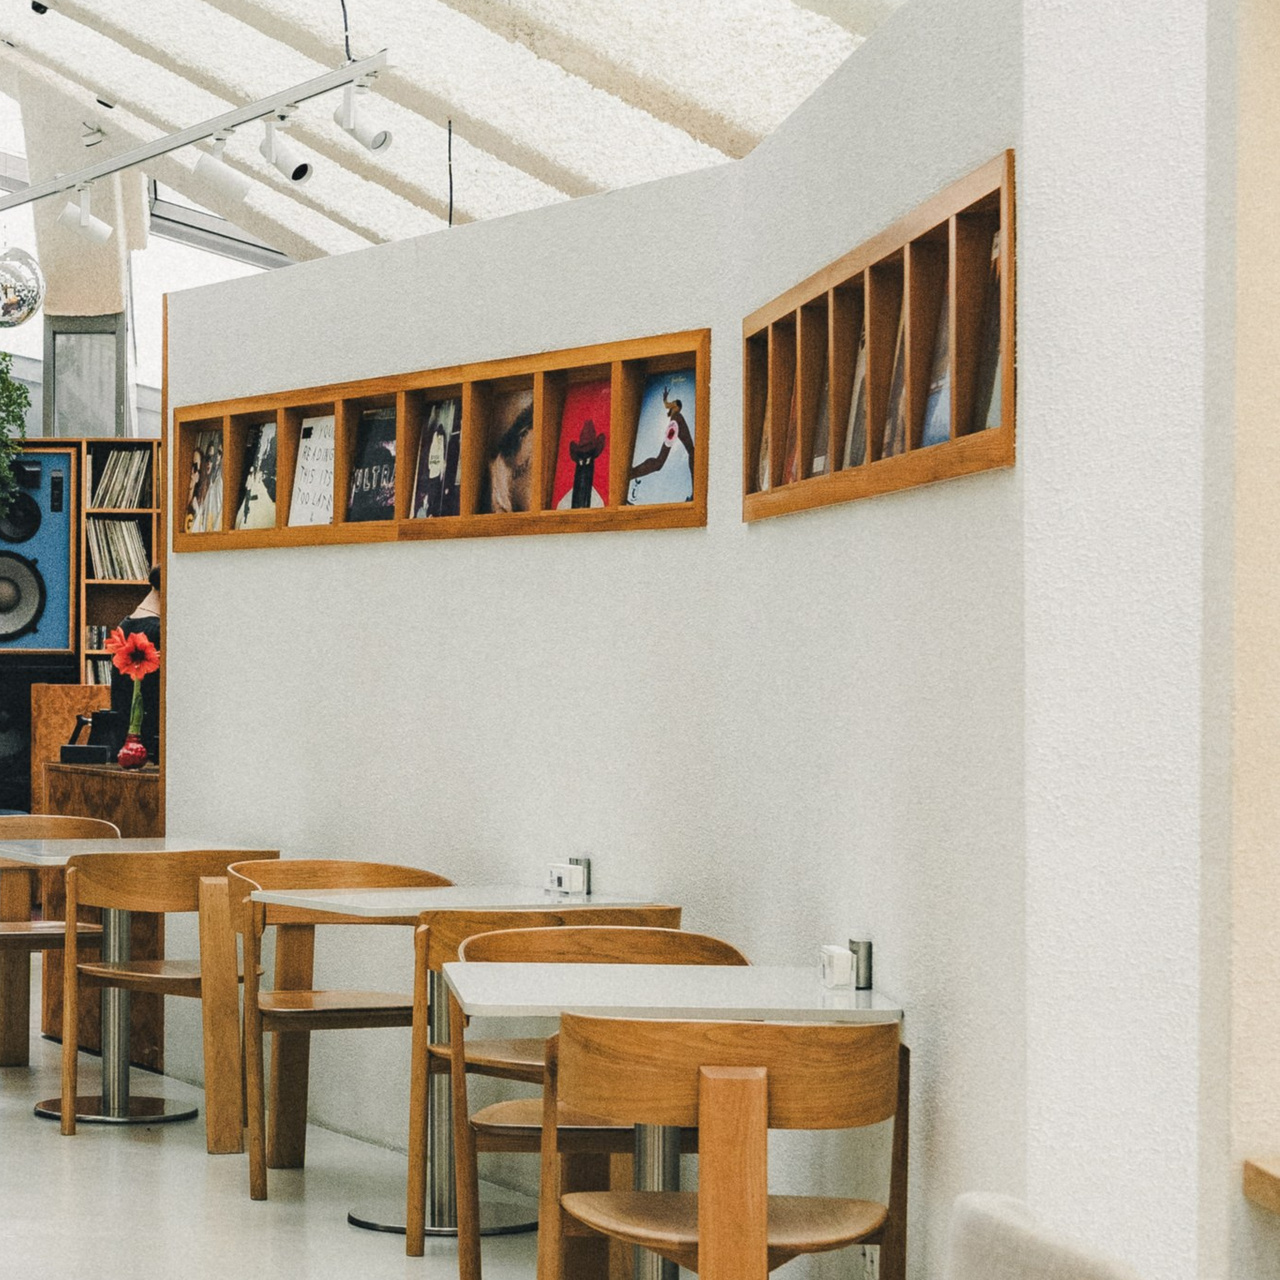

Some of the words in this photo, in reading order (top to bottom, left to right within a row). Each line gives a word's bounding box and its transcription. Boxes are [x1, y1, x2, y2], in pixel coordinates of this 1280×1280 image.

[303, 445, 334, 462] READING
[300, 465, 315, 485] THIS
[296, 487, 310, 505] TOO
[312, 492, 333, 511] LATE
